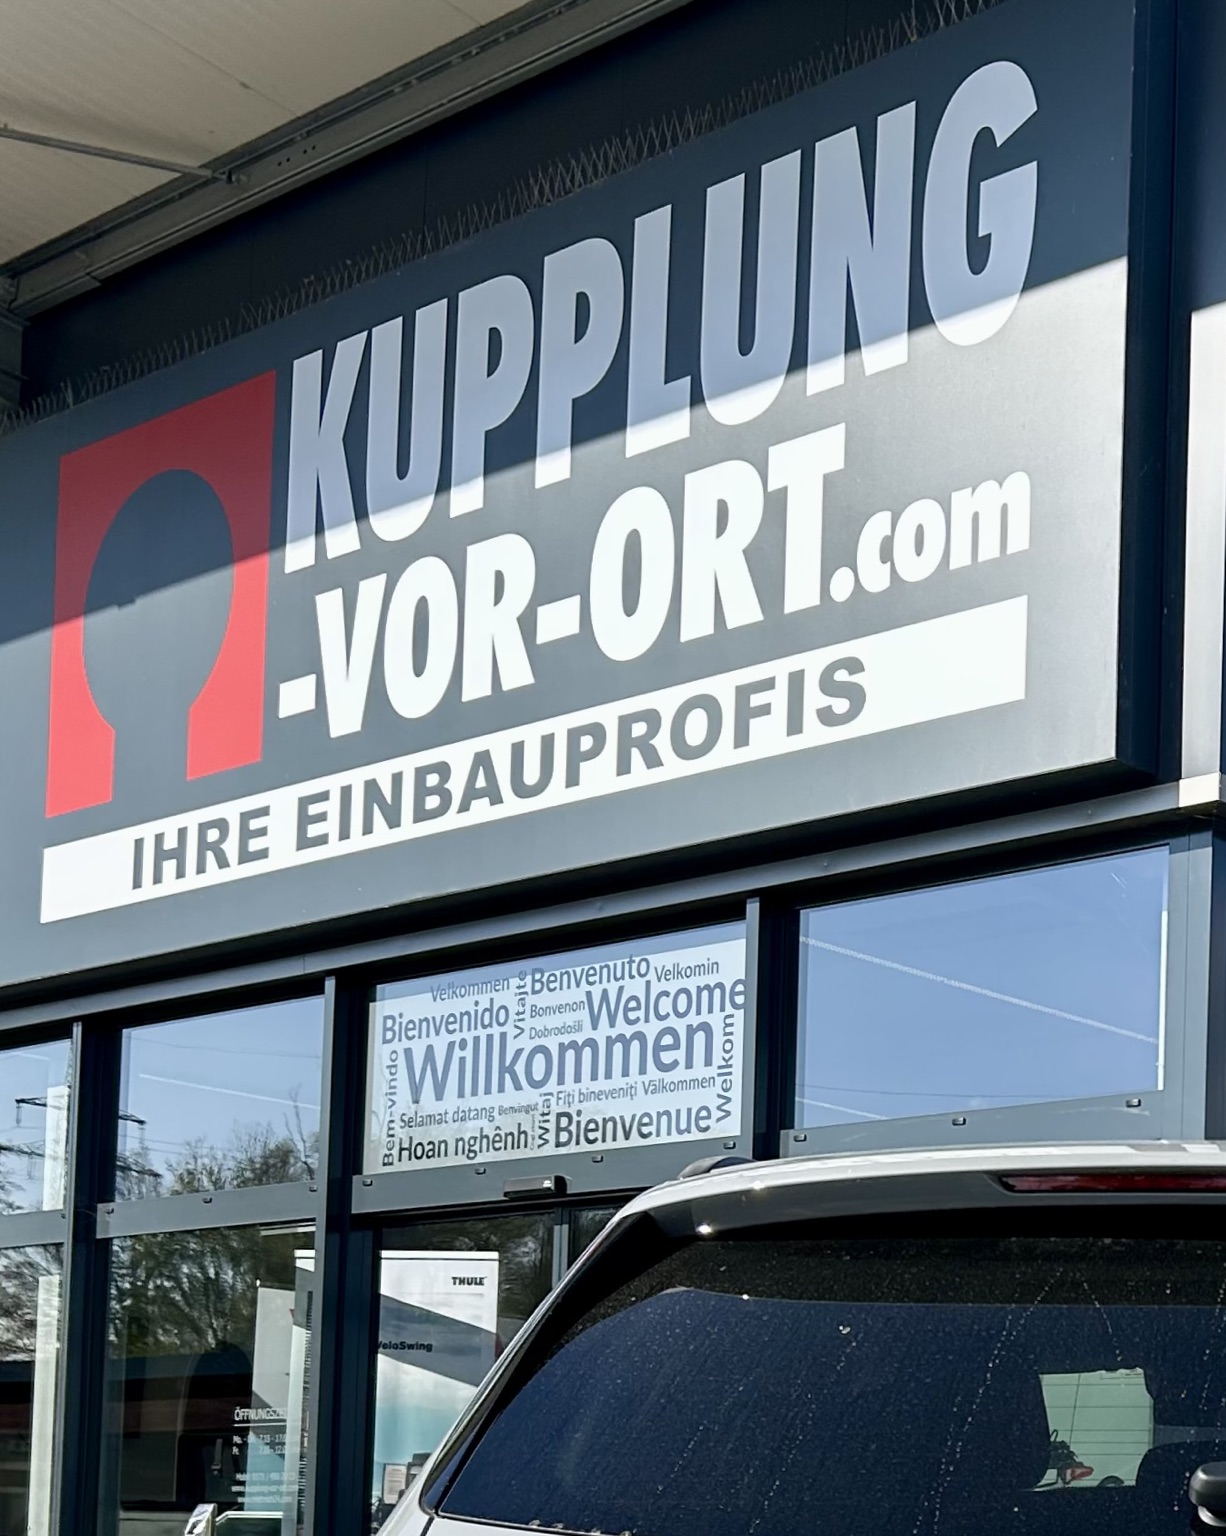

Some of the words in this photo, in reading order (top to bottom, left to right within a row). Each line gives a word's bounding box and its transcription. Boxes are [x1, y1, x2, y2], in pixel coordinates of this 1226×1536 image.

[283, 60, 1039, 573] KUPPLUNG
[278, 422, 1032, 740] -VOR-ORT.com
[130, 804, 272, 890] IHRE
[296, 654, 868, 852] EINBAUPROFIS
[430, 978, 511, 1003] Velkommen
[530, 954, 650, 996] Benvenuto
[654, 957, 720, 983] Velkomin
[381, 998, 510, 1045] Bienvenido
[513, 970, 529, 1040] Vitajte
[529, 999, 586, 1019] Bonvenon
[585, 978, 747, 1031] Welcome
[403, 1020, 714, 1105] Willkommen
[715, 1013, 735, 1124] Welkom
[382, 1049, 399, 1167] Bem-vindo
[399, 1110, 449, 1130] Selamat
[452, 1105, 495, 1124] datang
[554, 1104, 712, 1149] Bienvenue
[398, 1135, 449, 1163] Hoan
[454, 1122, 528, 1161] nghênh
[452, 1276, 485, 1286] THULE
